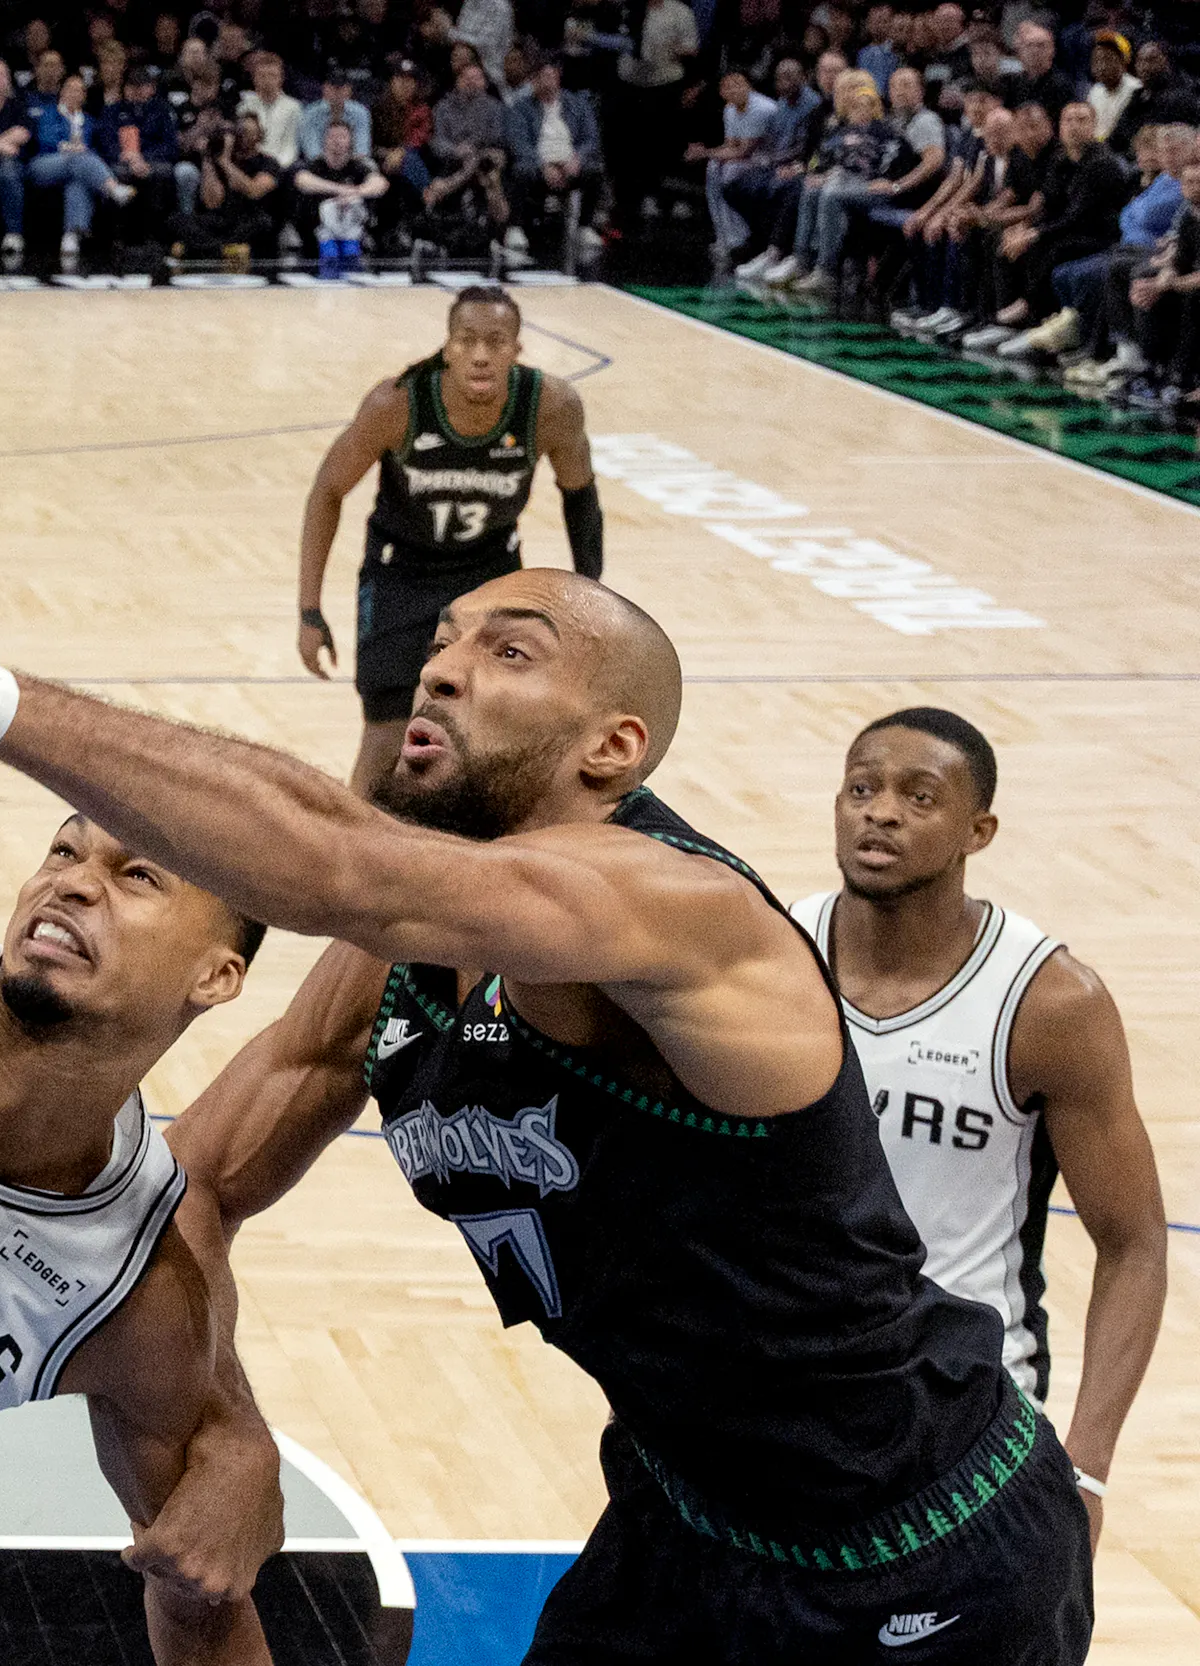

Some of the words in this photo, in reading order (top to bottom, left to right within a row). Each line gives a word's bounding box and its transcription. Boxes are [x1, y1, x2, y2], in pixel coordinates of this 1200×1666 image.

[427, 501, 490, 543] 13
[383, 1017, 411, 1043] NIKE
[916, 1048, 970, 1067] LEDGER
[385, 1096, 580, 1199] BERWOLVES
[13, 1242, 72, 1297] LEDGER
[447, 1207, 563, 1319] 7
[888, 1610, 939, 1635] NIKE
